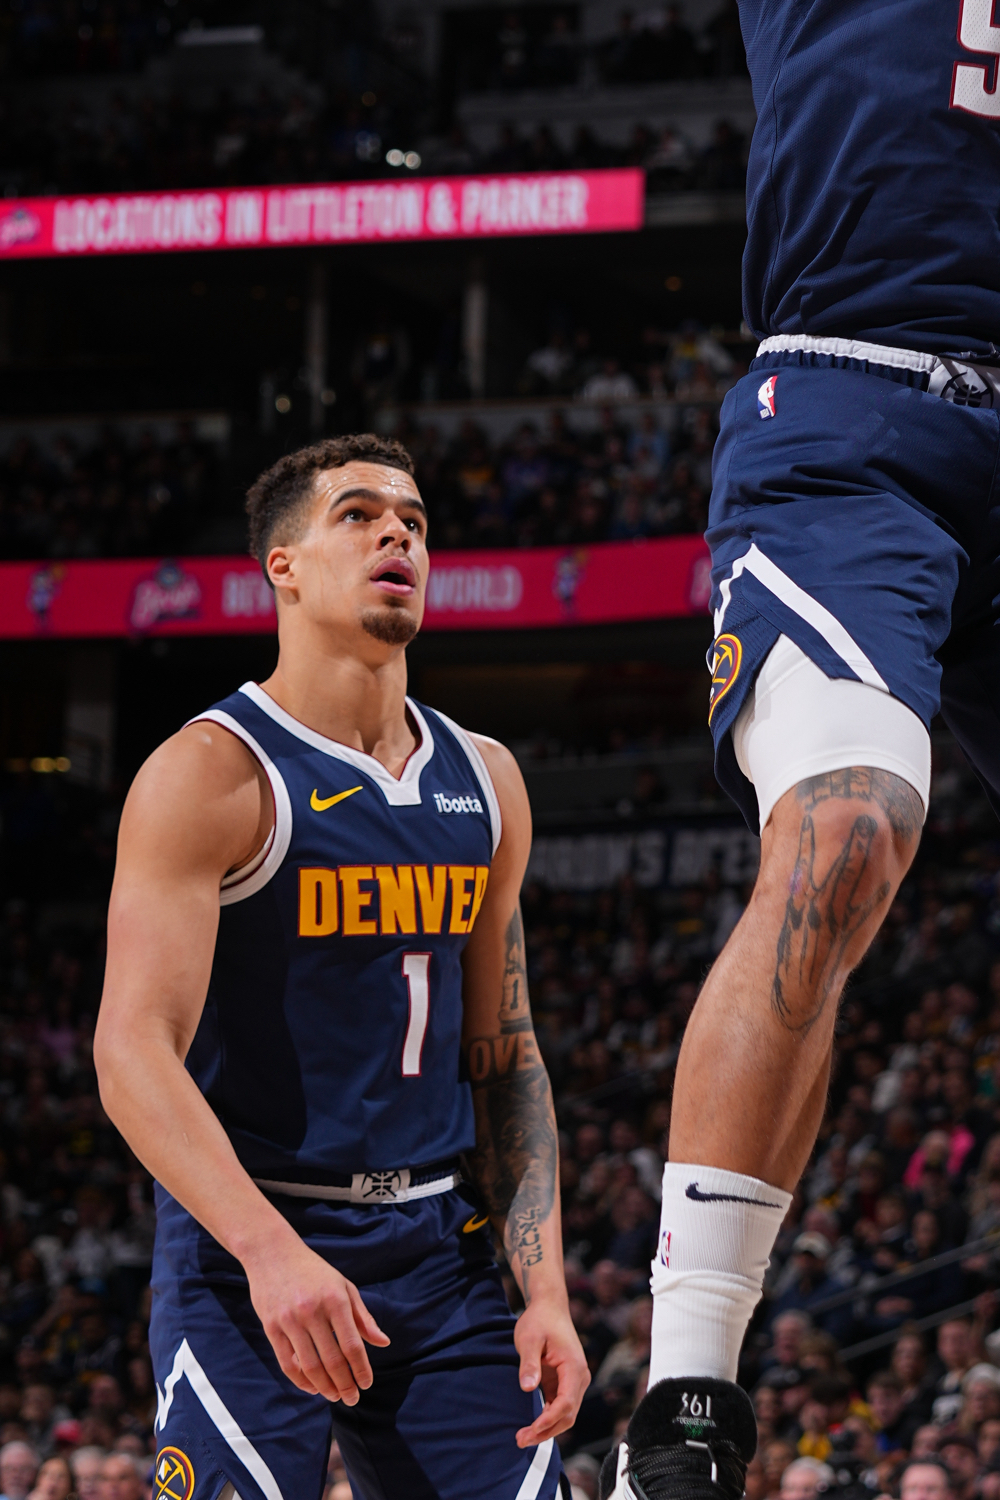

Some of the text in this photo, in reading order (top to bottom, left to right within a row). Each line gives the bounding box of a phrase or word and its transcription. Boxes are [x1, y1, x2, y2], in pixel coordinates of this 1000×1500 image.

[53, 192, 223, 252] LOCATIONS
[225, 190, 264, 244] IN
[266, 182, 425, 243] LITTLETON
[426, 181, 458, 234] &
[460, 175, 589, 234] PARKER
[426, 565, 523, 612] WORLD
[433, 792, 483, 813] ibotta
[402, 952, 432, 1077] 1
